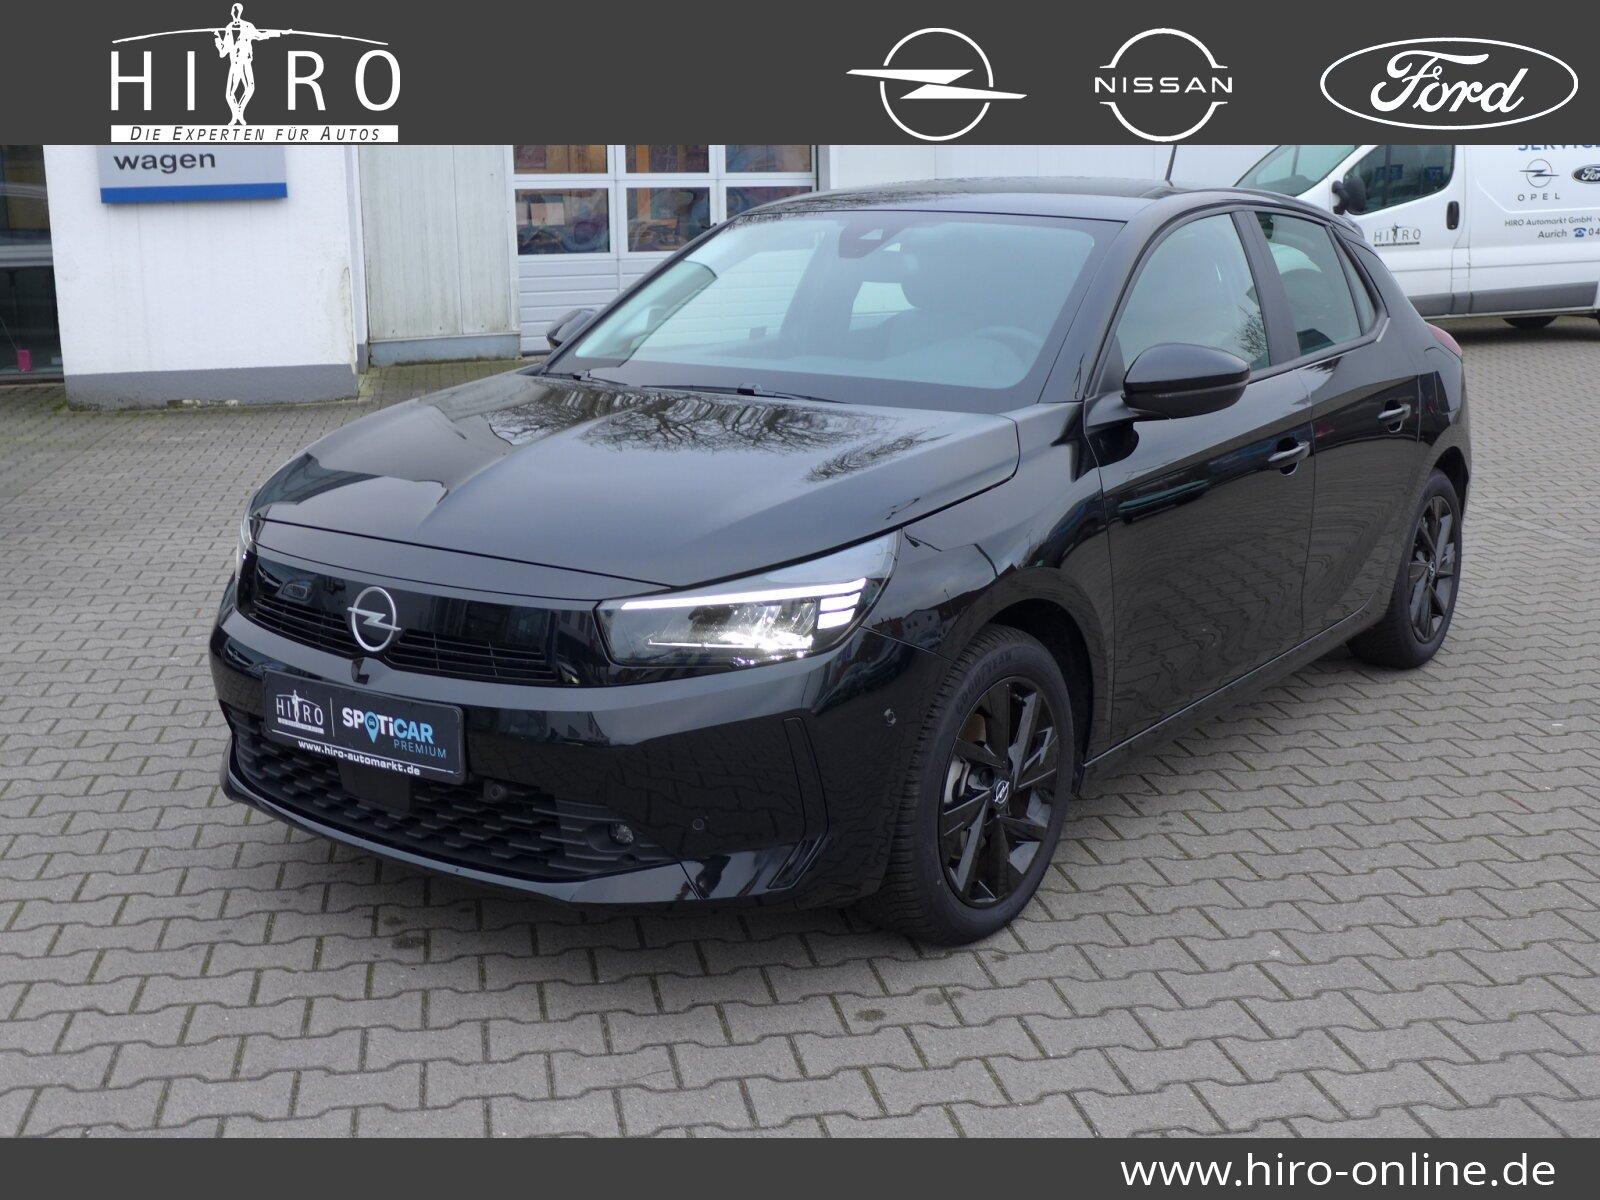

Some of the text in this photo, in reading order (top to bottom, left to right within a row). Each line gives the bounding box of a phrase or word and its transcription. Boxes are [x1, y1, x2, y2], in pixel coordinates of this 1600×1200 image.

[113, 153, 216, 174] wagen
[1517, 192, 1560, 202] OPEL
[1505, 216, 1592, 227] HIRO Automarkt GmbH
[1374, 228, 1421, 242] HIRO
[1537, 228, 1567, 239] Aurich
[276, 697, 323, 726] HIRO
[393, 738, 448, 759] PREMIUM
[298, 739, 421, 776] www.hiro-automarkt.de
